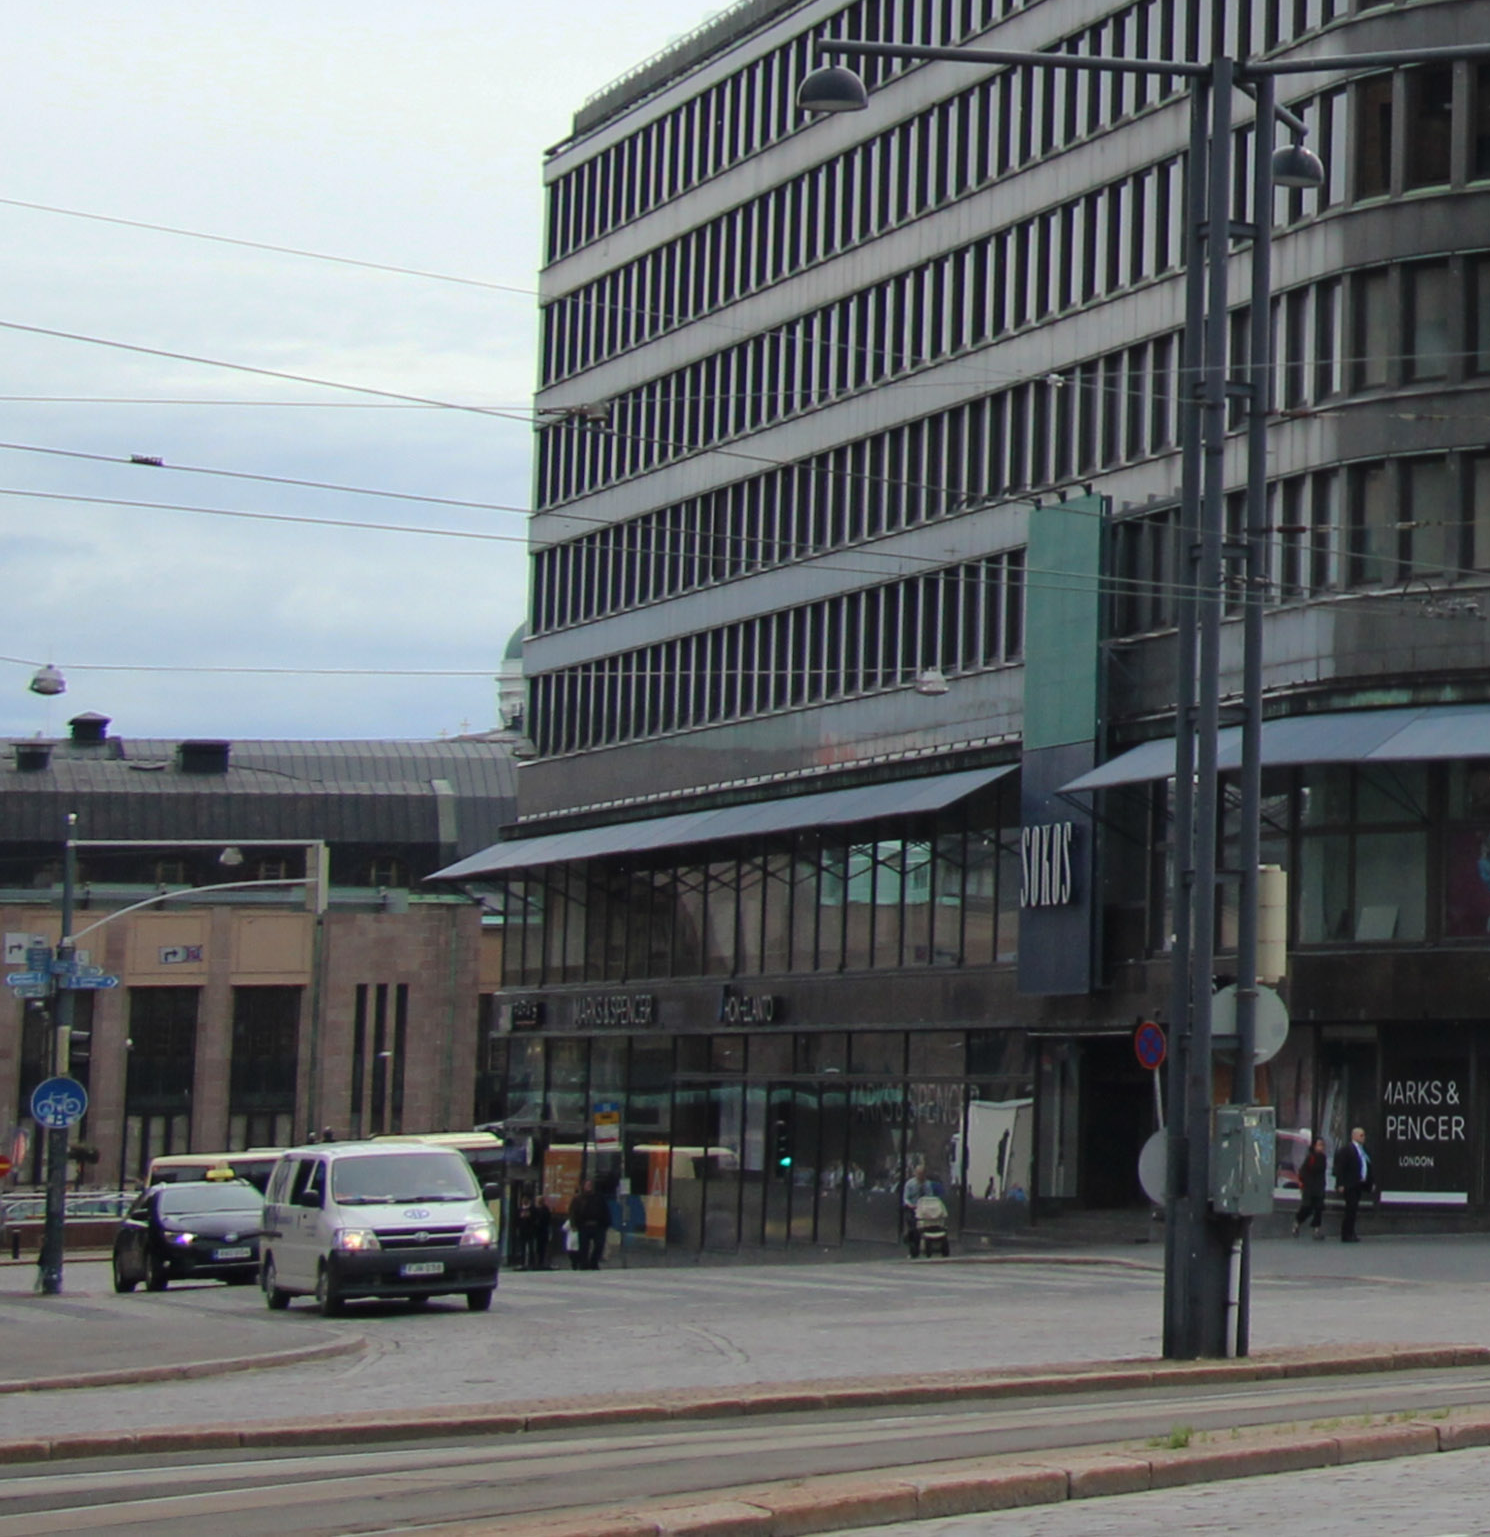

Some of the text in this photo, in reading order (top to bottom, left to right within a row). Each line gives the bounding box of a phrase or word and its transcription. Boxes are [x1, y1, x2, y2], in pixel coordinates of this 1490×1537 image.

[1020, 821, 1072, 908] SOKOS
[1446, 1080, 1460, 1104] &
[1386, 1116, 1466, 1141] PENCER
[1398, 1155, 1435, 1167] LONDON
